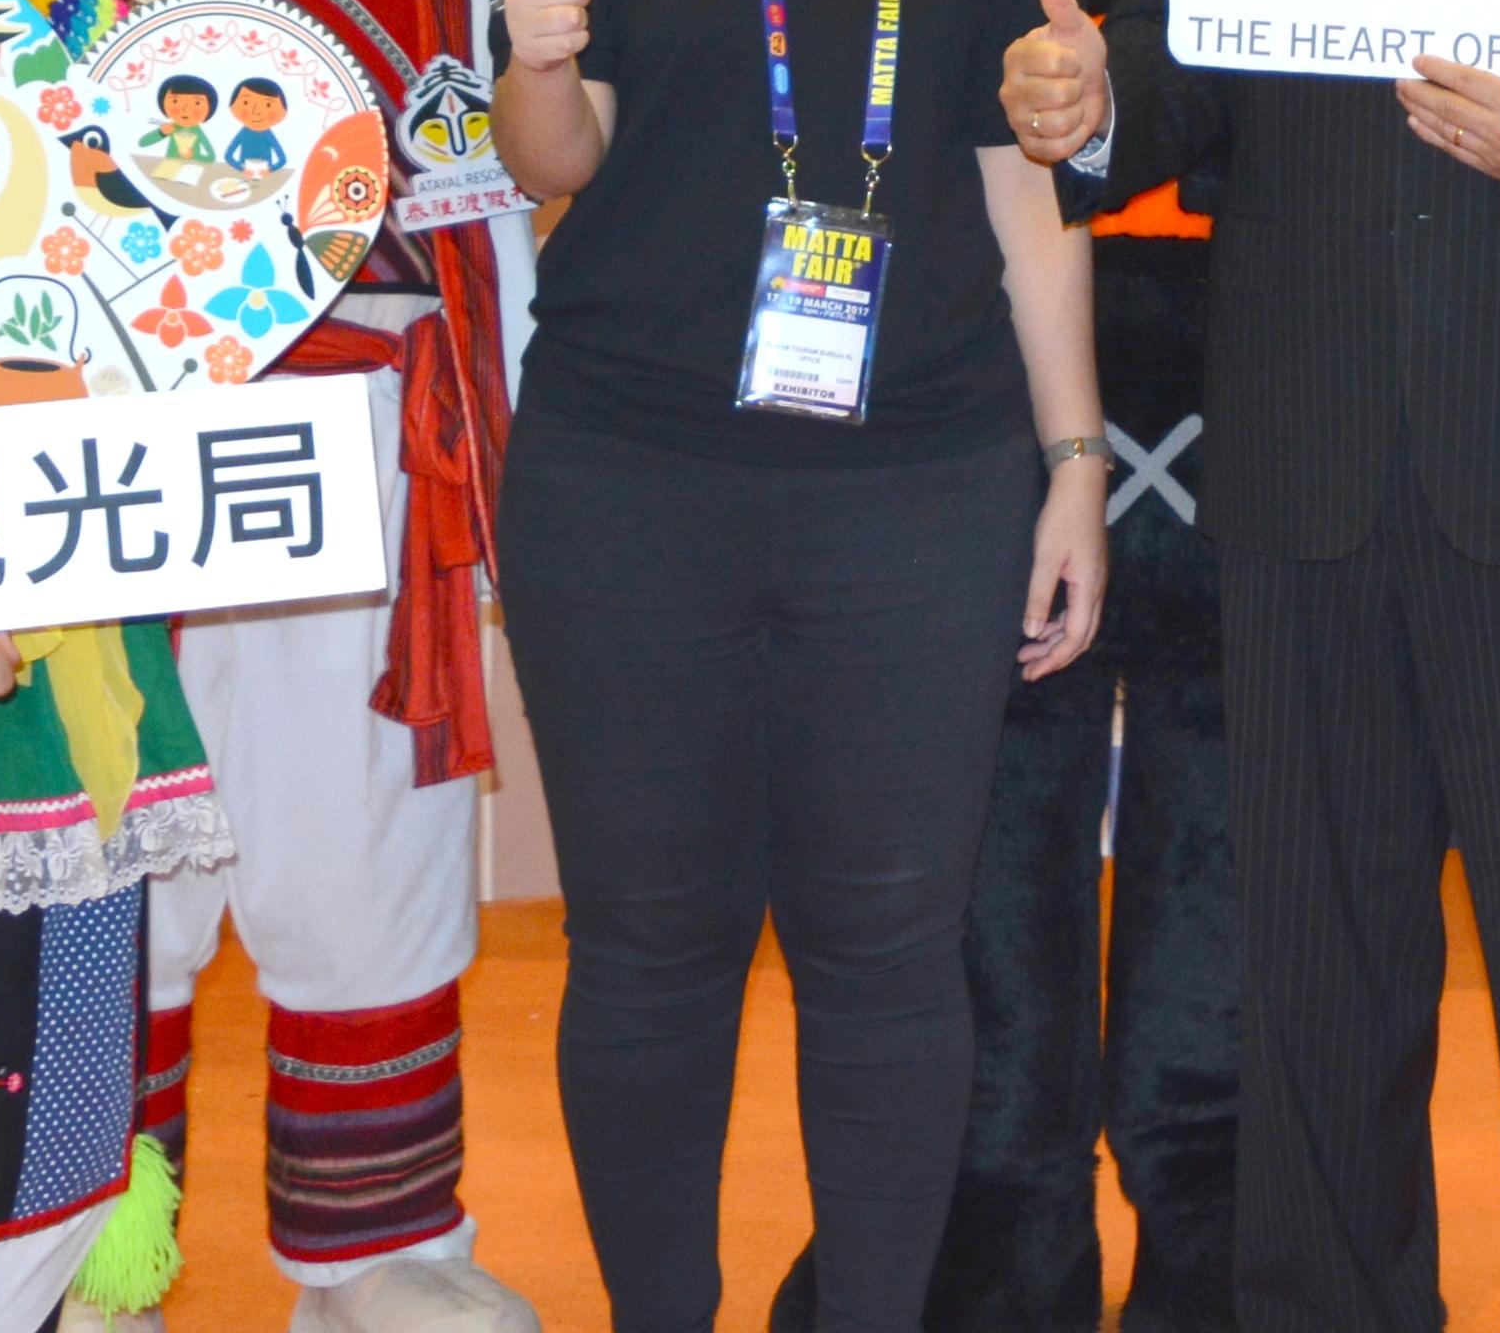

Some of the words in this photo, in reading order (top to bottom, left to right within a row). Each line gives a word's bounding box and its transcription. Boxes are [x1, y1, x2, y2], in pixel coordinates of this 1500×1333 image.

[1188, 16, 1273, 58] THE
[1290, 23, 1436, 67] HEART
[870, 36, 898, 106] MATTA
[418, 176, 463, 193] ATAYAL
[783, 225, 871, 262] MATTA
[792, 252, 853, 284] FAIR
[803, 297, 843, 313] MARCH
[844, 303, 870, 317] 2017
[773, 382, 836, 400] EXHIBITOR
